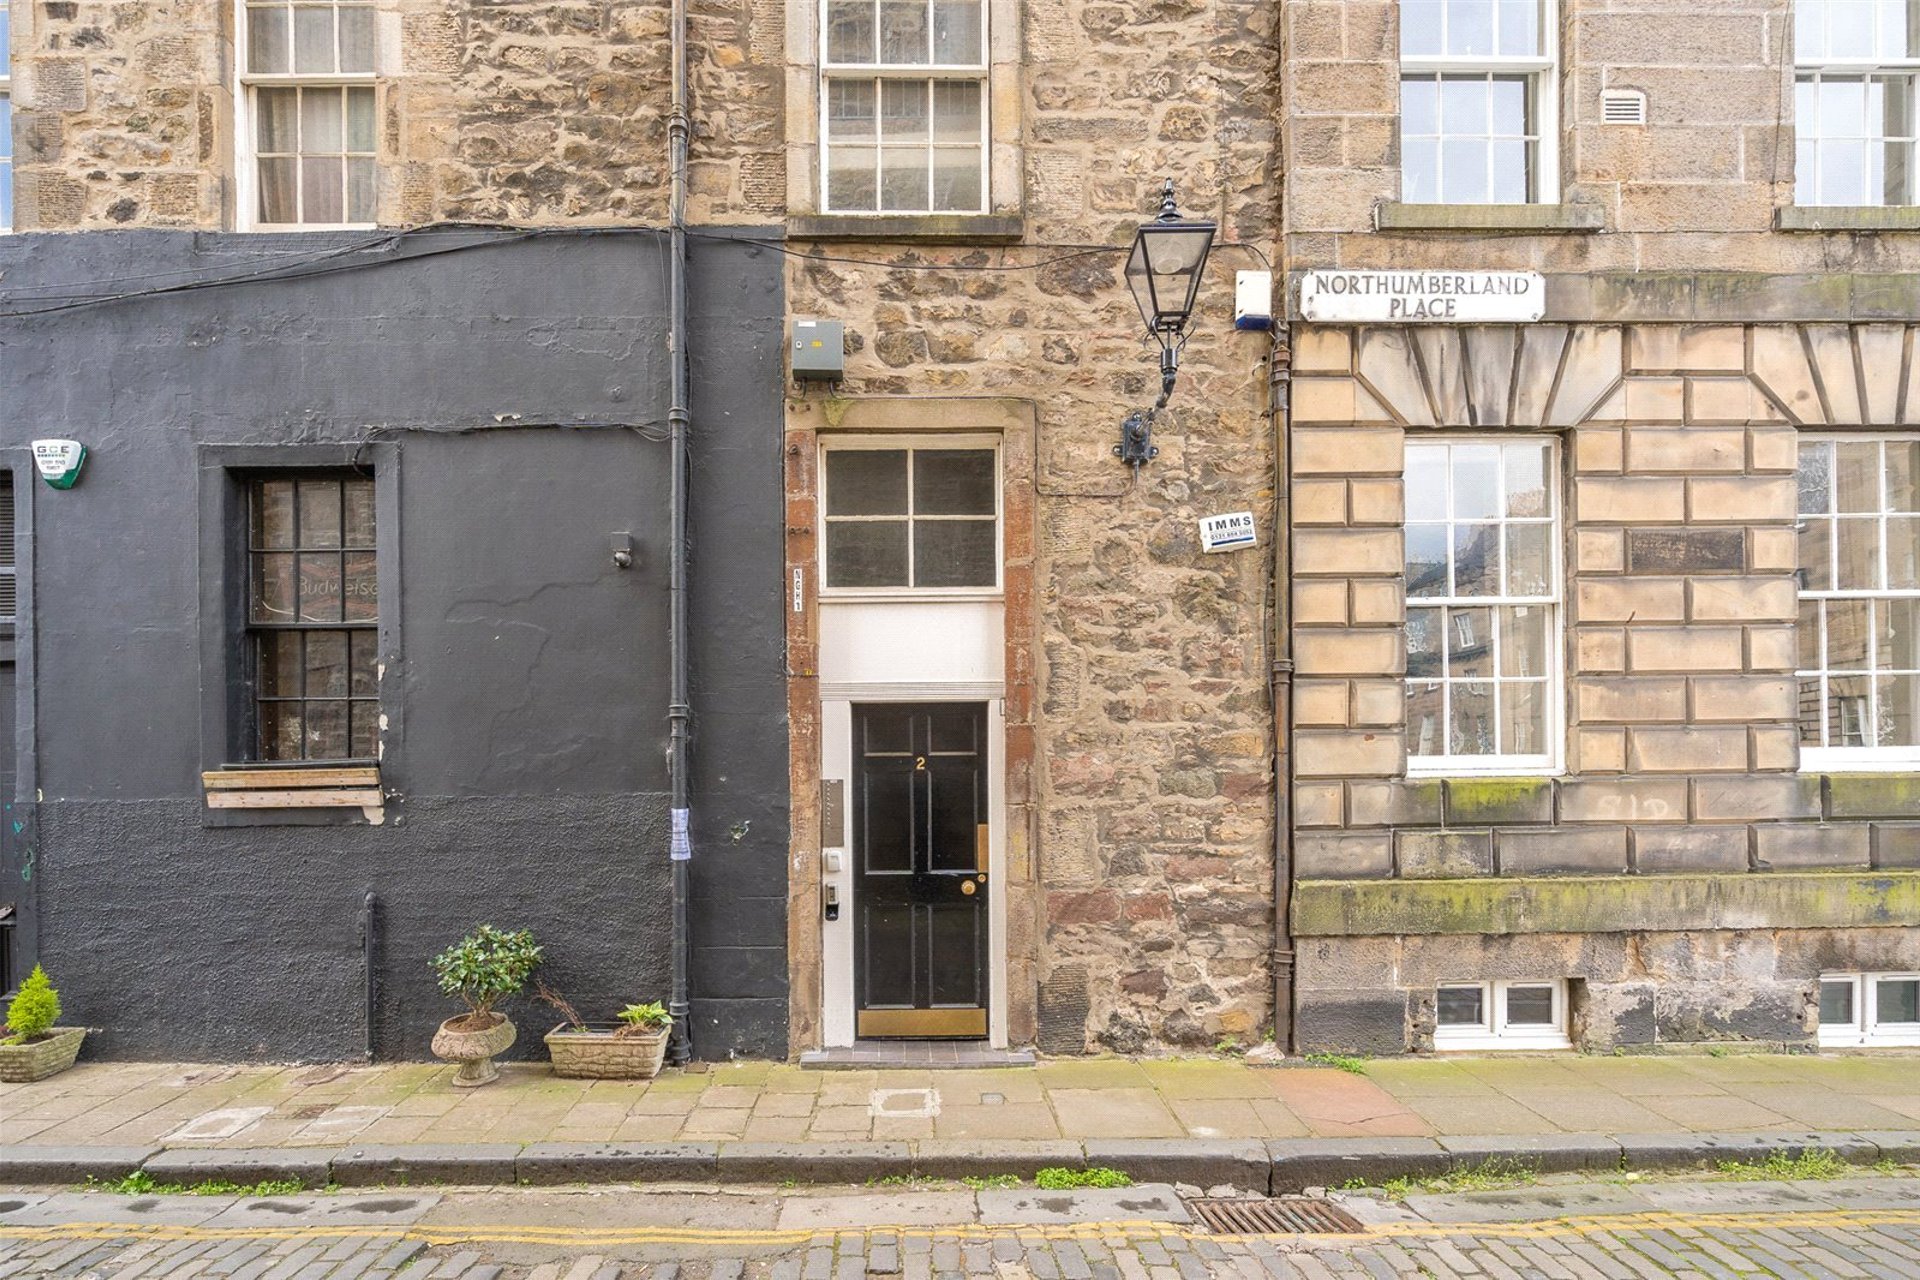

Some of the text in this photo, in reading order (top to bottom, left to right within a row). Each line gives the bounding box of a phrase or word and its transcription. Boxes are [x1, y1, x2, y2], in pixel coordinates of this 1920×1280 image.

[1315, 275, 1529, 295] NORTHUMBERLAND
[1390, 298, 1456, 318] PLACE
[1208, 516, 1251, 531] IMMS
[299, 576, 378, 596] Budweise
[916, 757, 925, 770] 2
